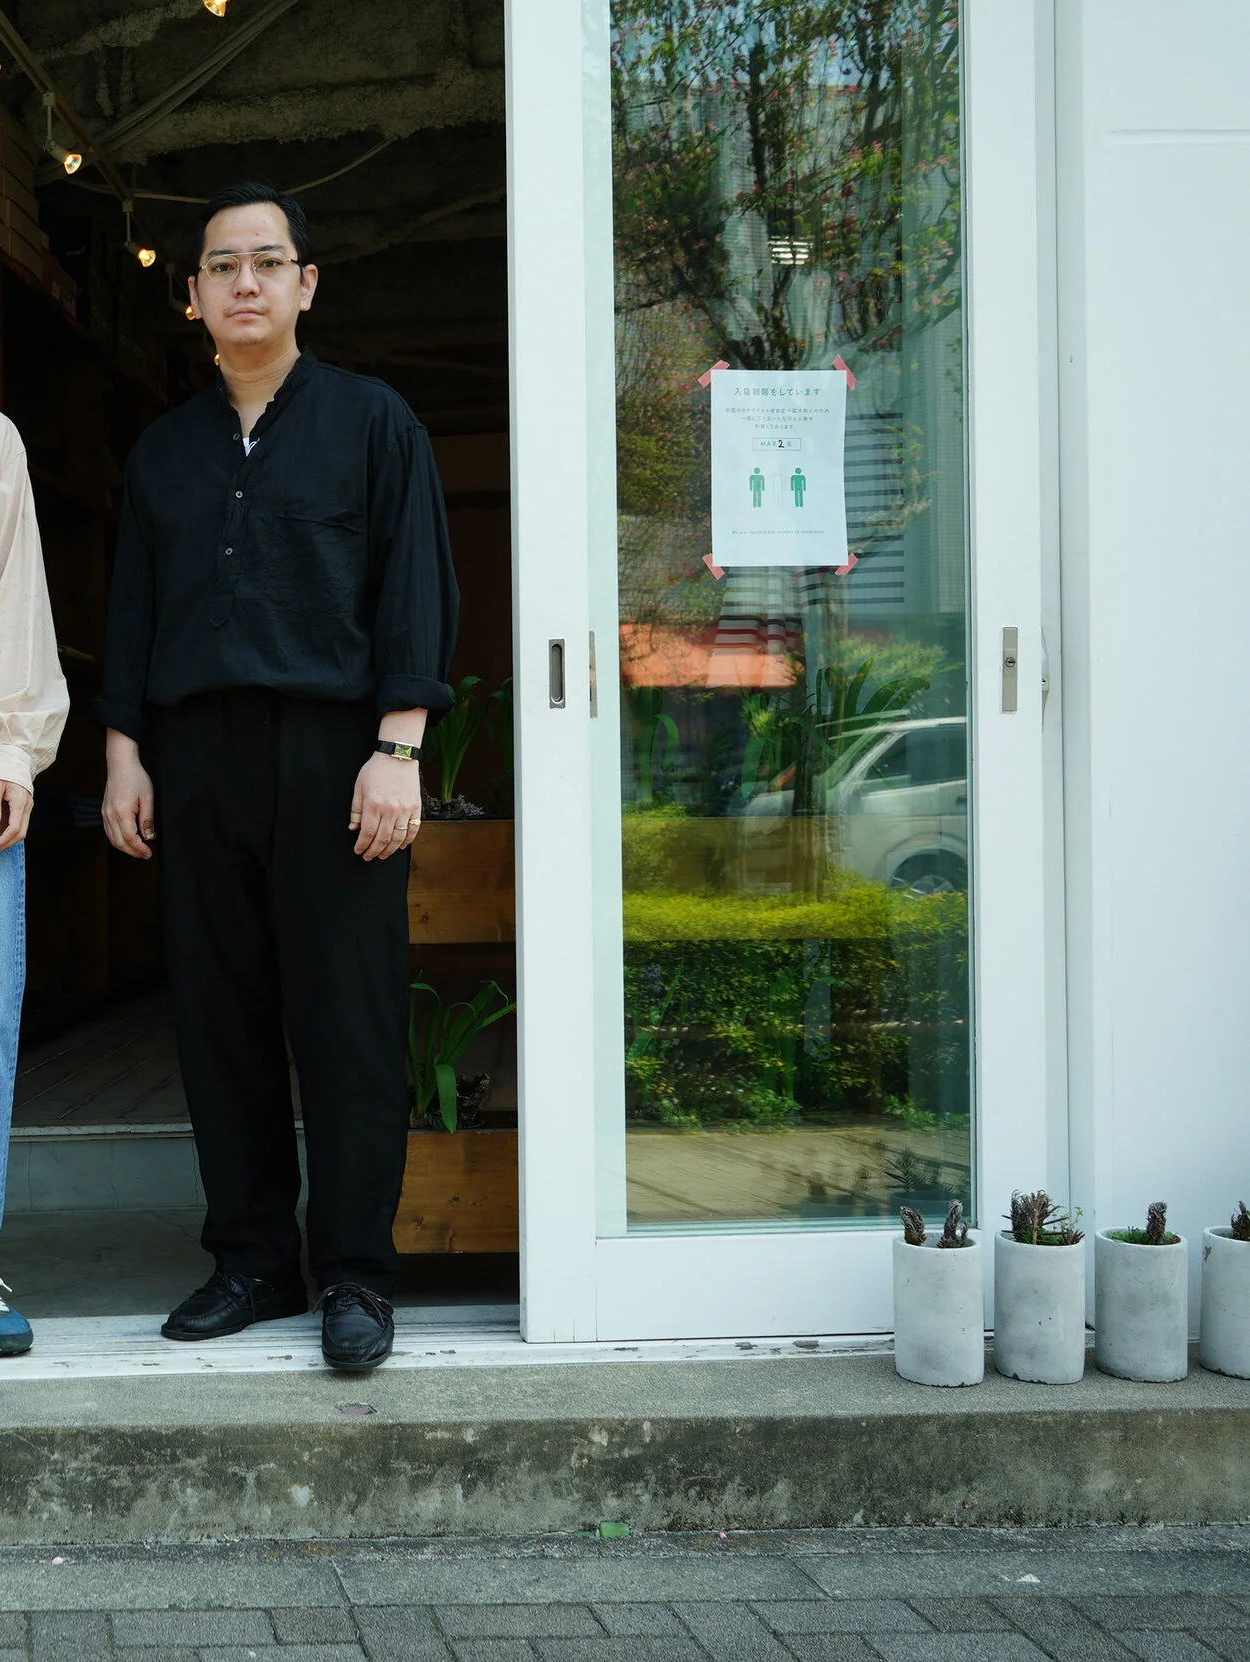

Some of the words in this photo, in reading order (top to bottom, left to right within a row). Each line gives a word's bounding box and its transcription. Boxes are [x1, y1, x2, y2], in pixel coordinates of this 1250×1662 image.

[734, 387, 821, 396] 入店制限をしています
[778, 439, 785, 448] 2
